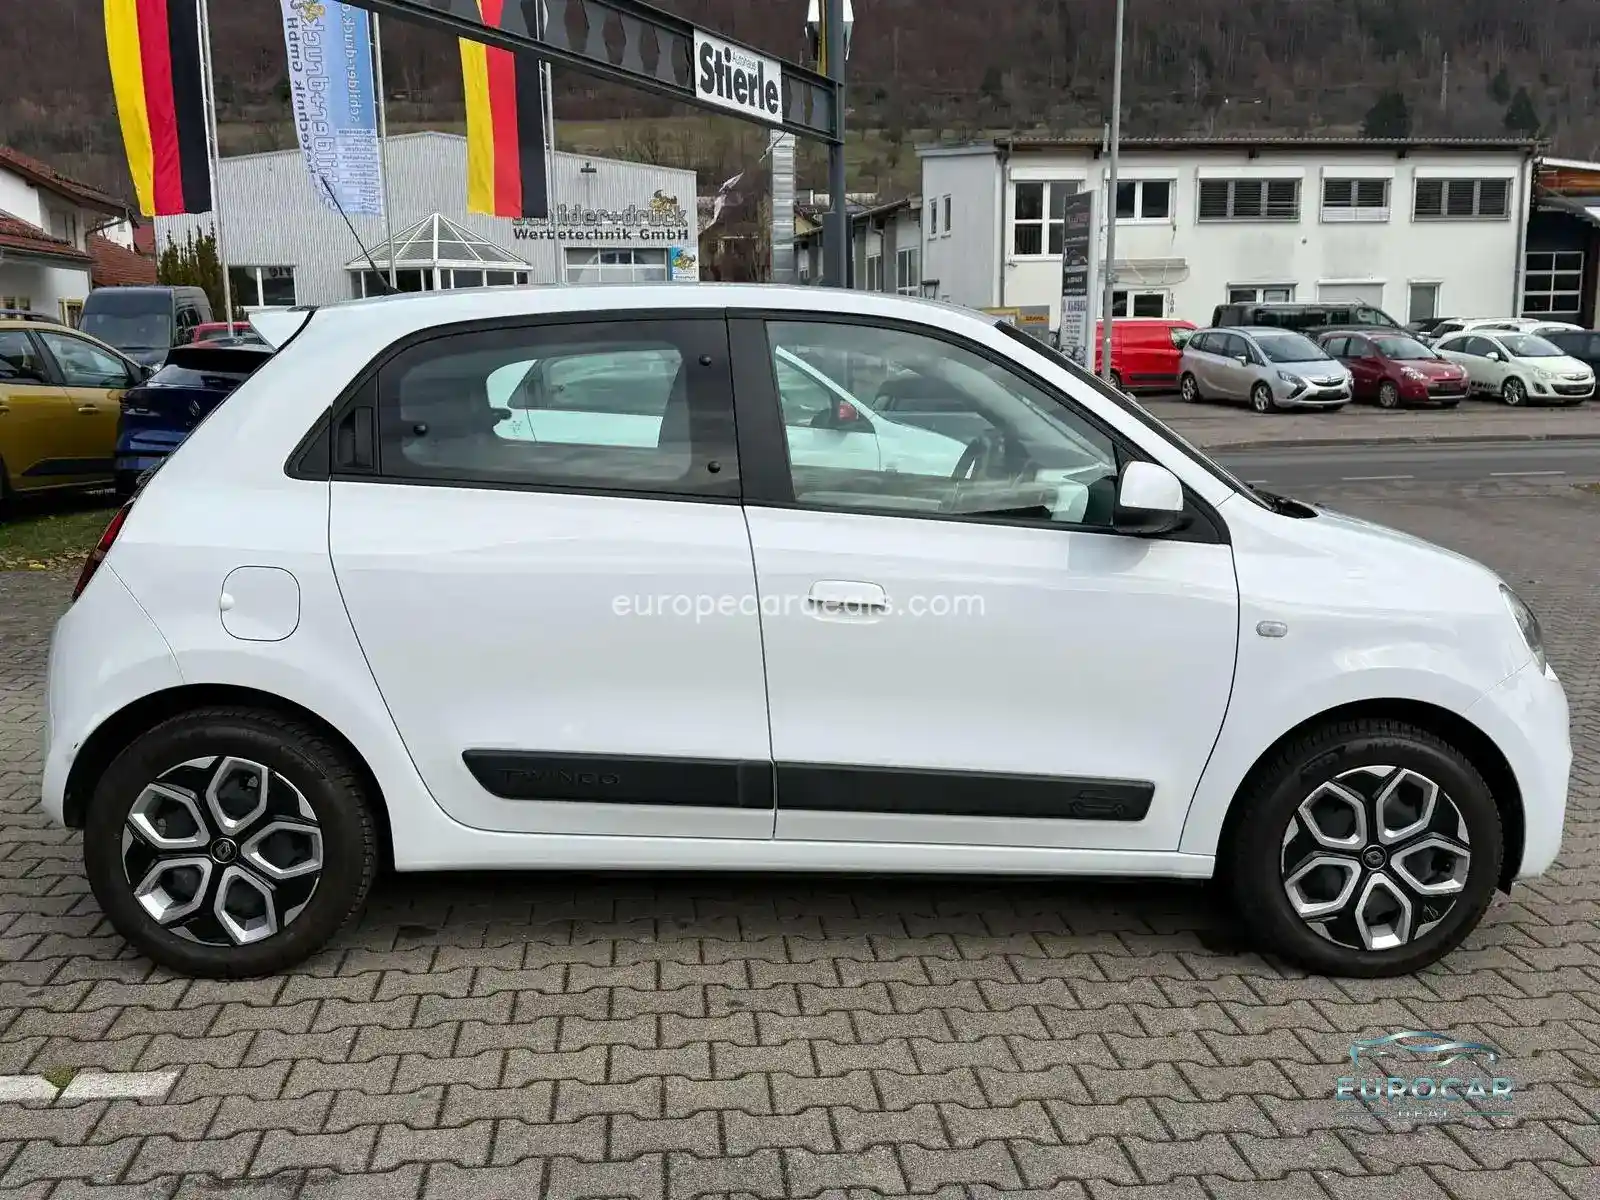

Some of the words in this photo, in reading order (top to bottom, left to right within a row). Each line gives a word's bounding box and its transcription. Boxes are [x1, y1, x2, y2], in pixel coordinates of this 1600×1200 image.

[699, 41, 779, 115] Stierle
[513, 227, 632, 240] Werbetechnik
[639, 229, 689, 240] GmbH
